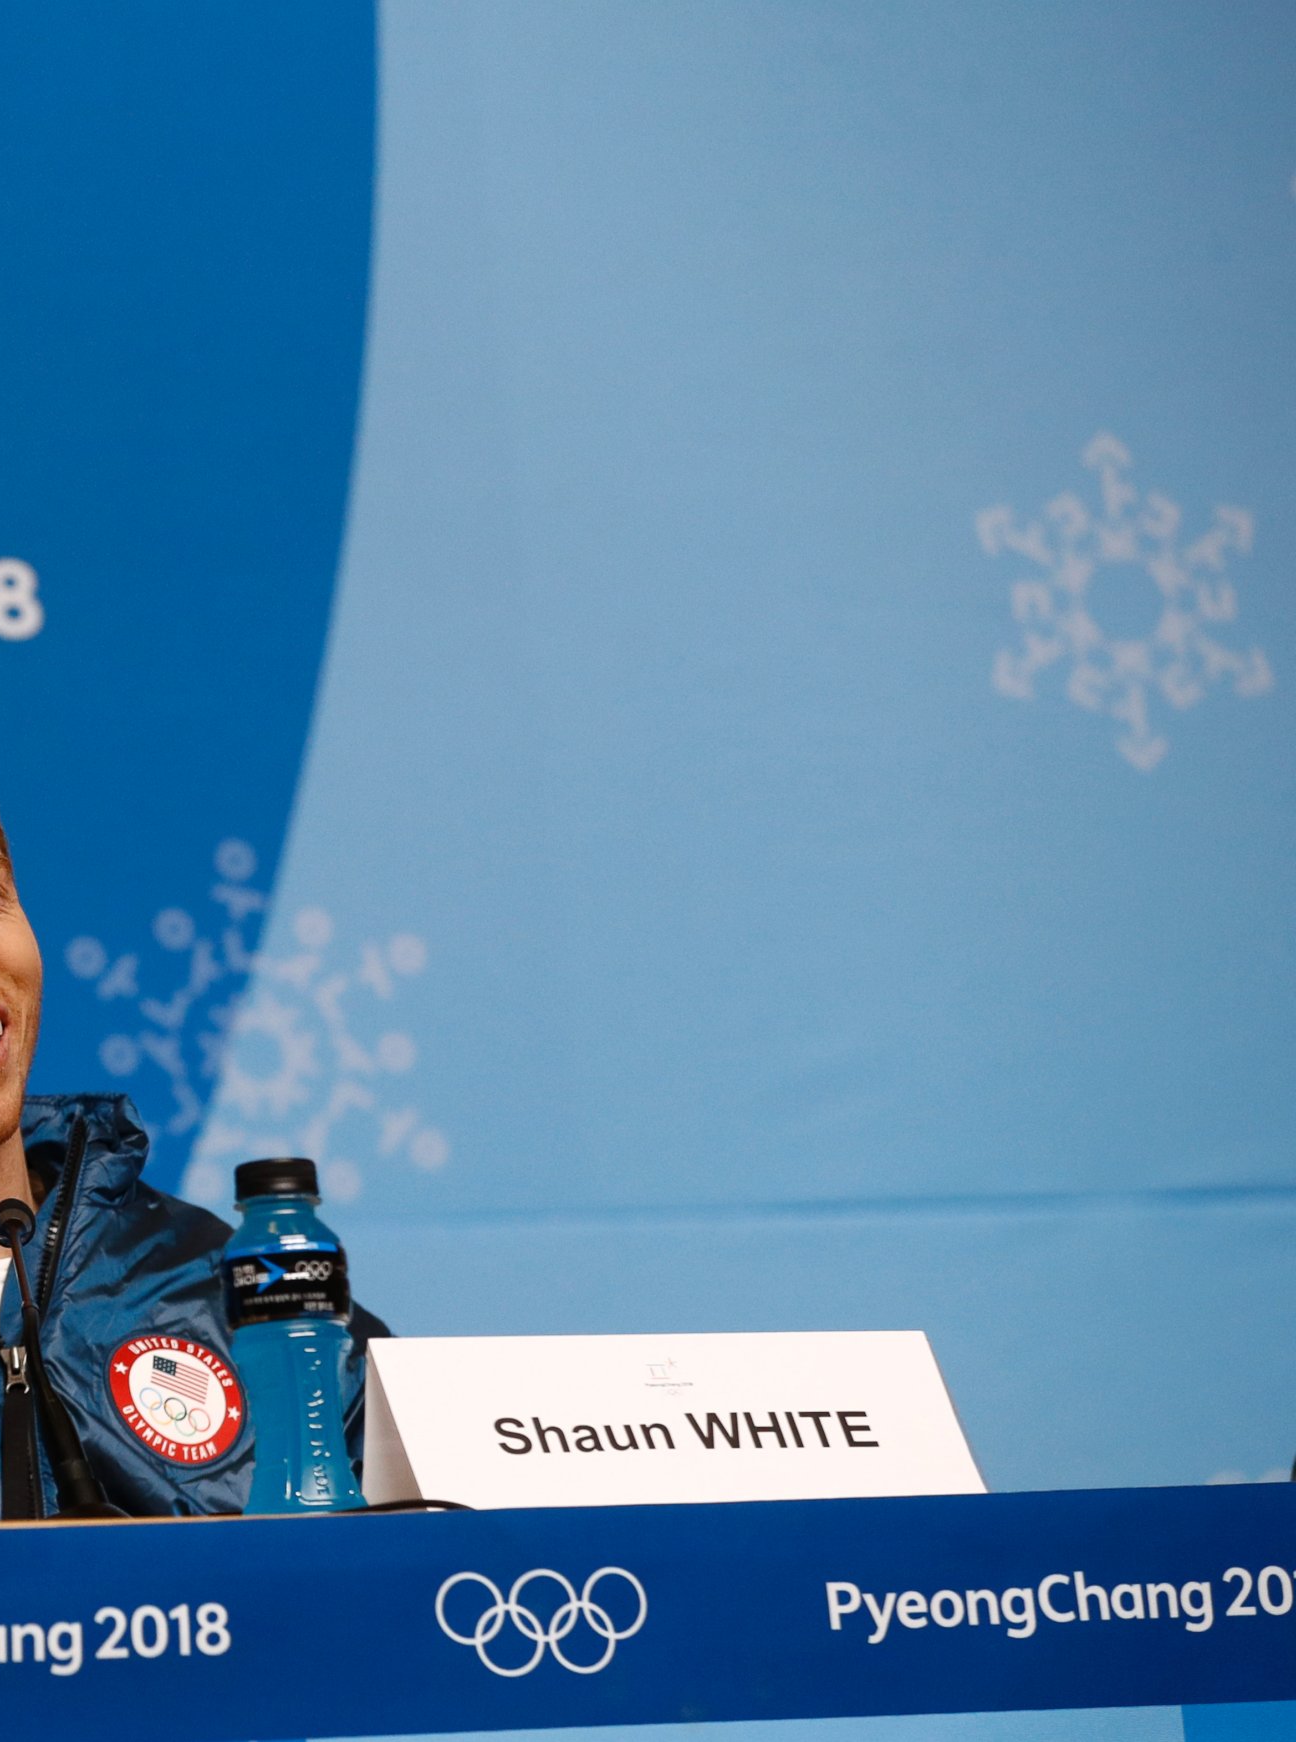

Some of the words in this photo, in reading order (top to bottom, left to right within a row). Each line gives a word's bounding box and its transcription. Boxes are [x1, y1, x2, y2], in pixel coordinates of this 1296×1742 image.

[128, 1337, 179, 1354] UNITED
[187, 1344, 233, 1387] STATES
[122, 1405, 176, 1457] OLYMPIC
[183, 1443, 217, 1460] TEAM
[494, 1416, 676, 1455] Shaun
[684, 1411, 880, 1450] WHITE
[94, 1602, 231, 1659] 2018
[826, 1571, 1214, 1644] PyeongChang
[1222, 1565, 1296, 1616] 20
